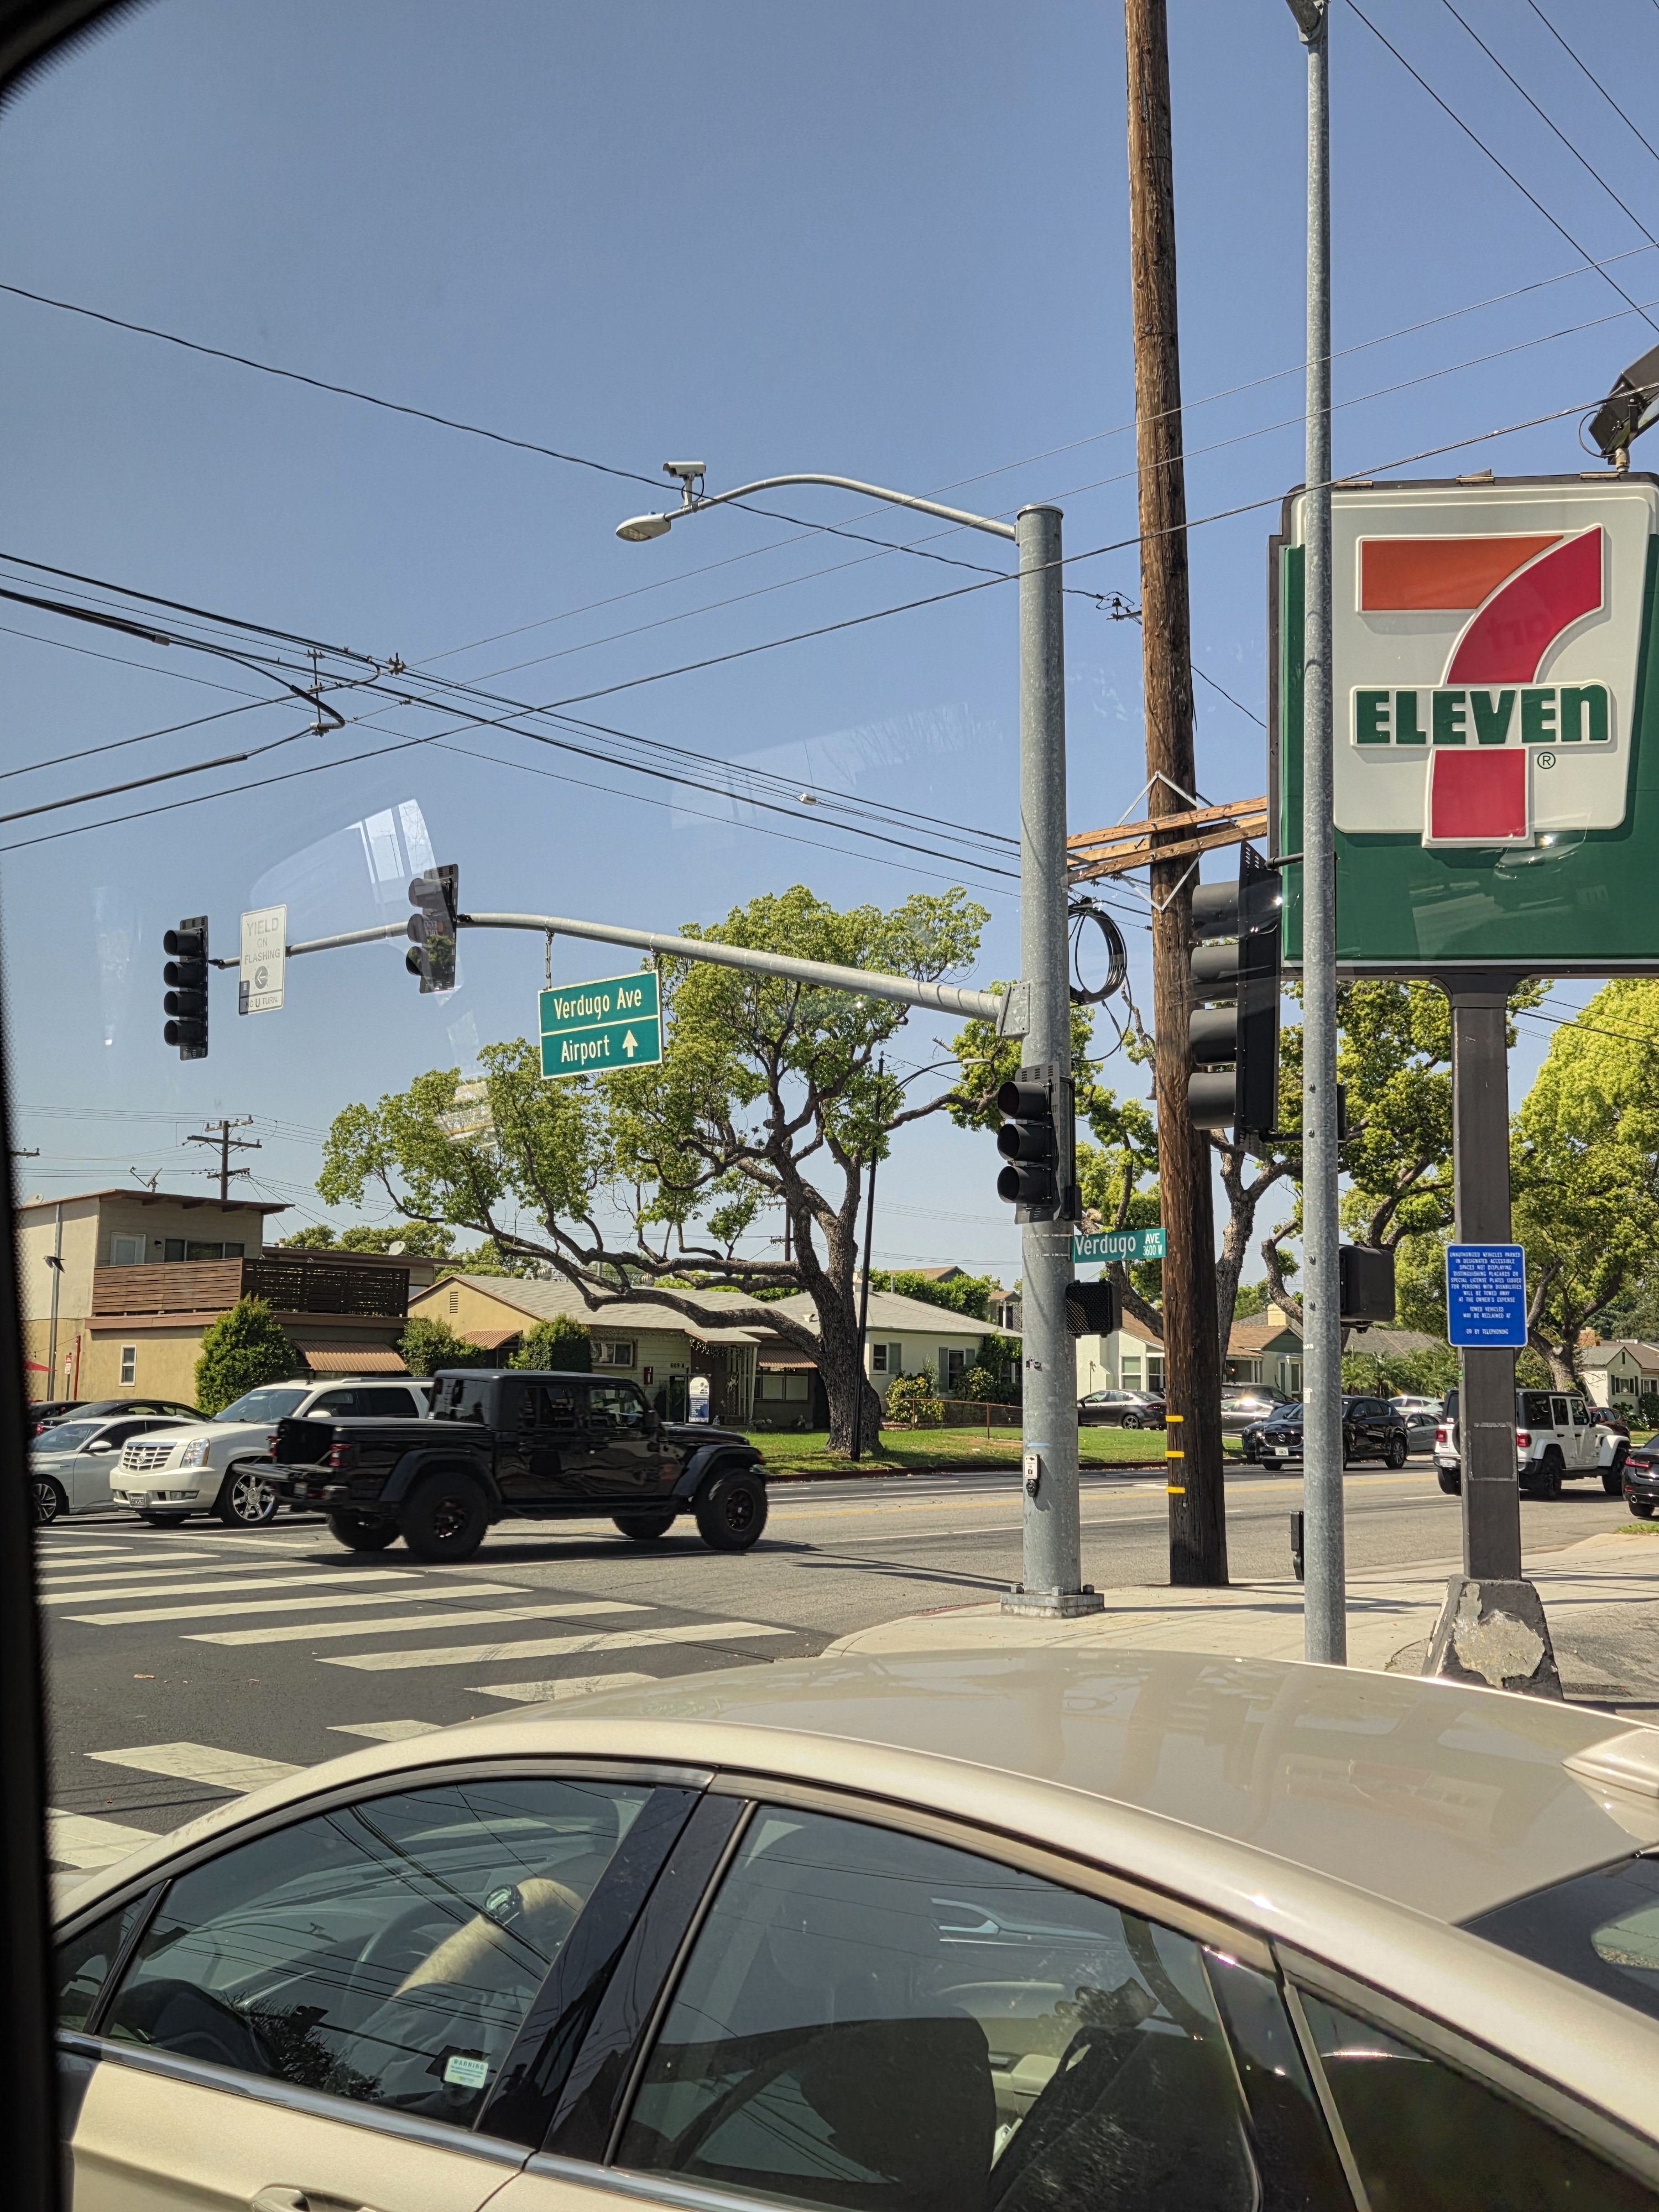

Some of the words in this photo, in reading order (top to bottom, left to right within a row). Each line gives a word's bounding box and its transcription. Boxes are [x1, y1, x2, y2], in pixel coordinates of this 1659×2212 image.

[1362, 527, 1602, 839] 7
[247, 917, 279, 936] YIELD
[257, 937, 268, 948] ON
[244, 949, 280, 964] FLASHING
[246, 1000, 254, 1009] NO
[255, 998, 260, 1007] U
[554, 995, 609, 1020] Verdugo
[617, 988, 642, 1010] Ave
[561, 1035, 609, 1065] Airport
[1145, 1233, 1160, 1244] AVE
[1074, 1234, 1136, 1259] Verdugo
[1143, 1245, 1156, 1256] 3600
[1157, 1245, 1162, 1255] W
[454, 2059, 484, 2070] WARNING
